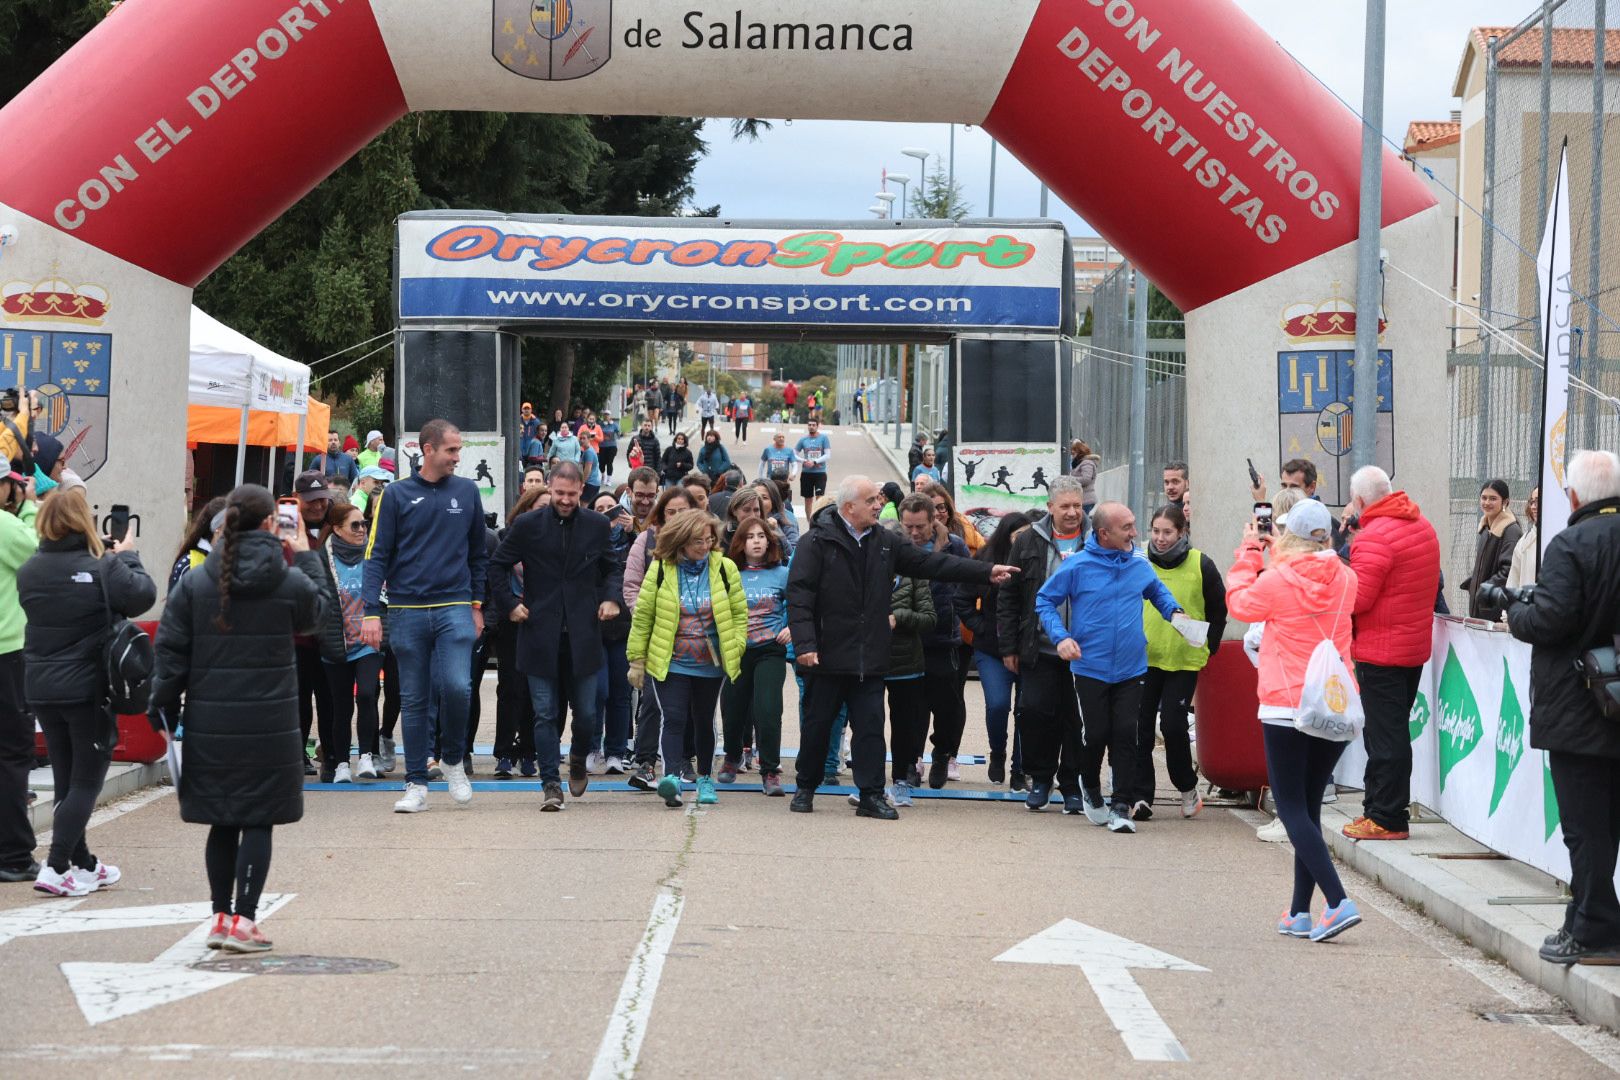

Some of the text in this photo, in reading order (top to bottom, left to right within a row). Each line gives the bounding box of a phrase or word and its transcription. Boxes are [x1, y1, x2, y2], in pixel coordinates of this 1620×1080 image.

[624, 10, 914, 51] de Salamanca
[54, 0, 344, 231] CON EL DEPORT
[1056, 26, 1288, 244] DEPORTISTAS
[1087, 0, 1340, 220] ON NUESTROS
[487, 290, 972, 315] www.orycronsport.com
[1311, 711, 1355, 735] UPSA
